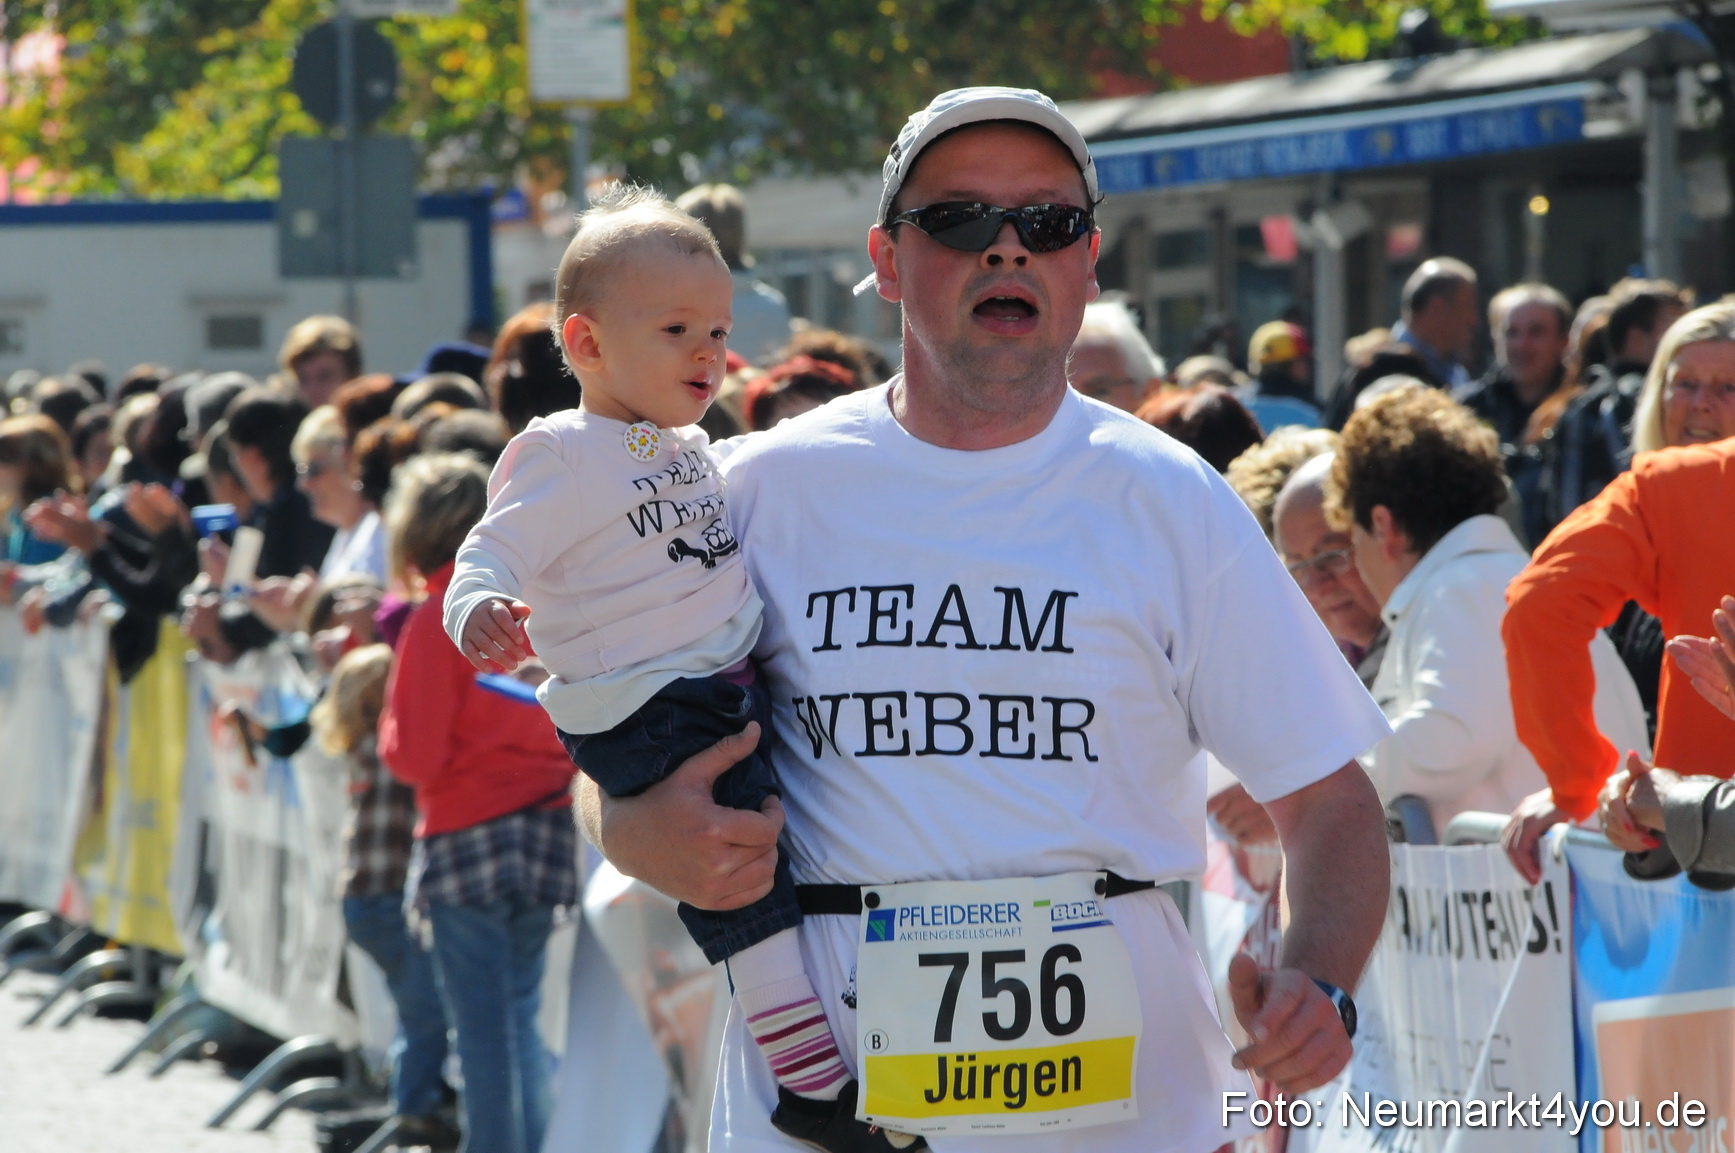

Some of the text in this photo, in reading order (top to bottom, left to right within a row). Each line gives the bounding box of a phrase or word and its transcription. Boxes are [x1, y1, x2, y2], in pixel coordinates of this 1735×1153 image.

[806, 584, 1079, 653] TEAM
[792, 691, 1099, 762] WEBER
[899, 902, 1022, 928] PFLEIDERER
[899, 926, 1023, 942] AKTIENGESELLSCHAFT
[918, 943, 1086, 1044] 756
[871, 1033, 882, 1051] B
[924, 1054, 1082, 1110] Jürgen
